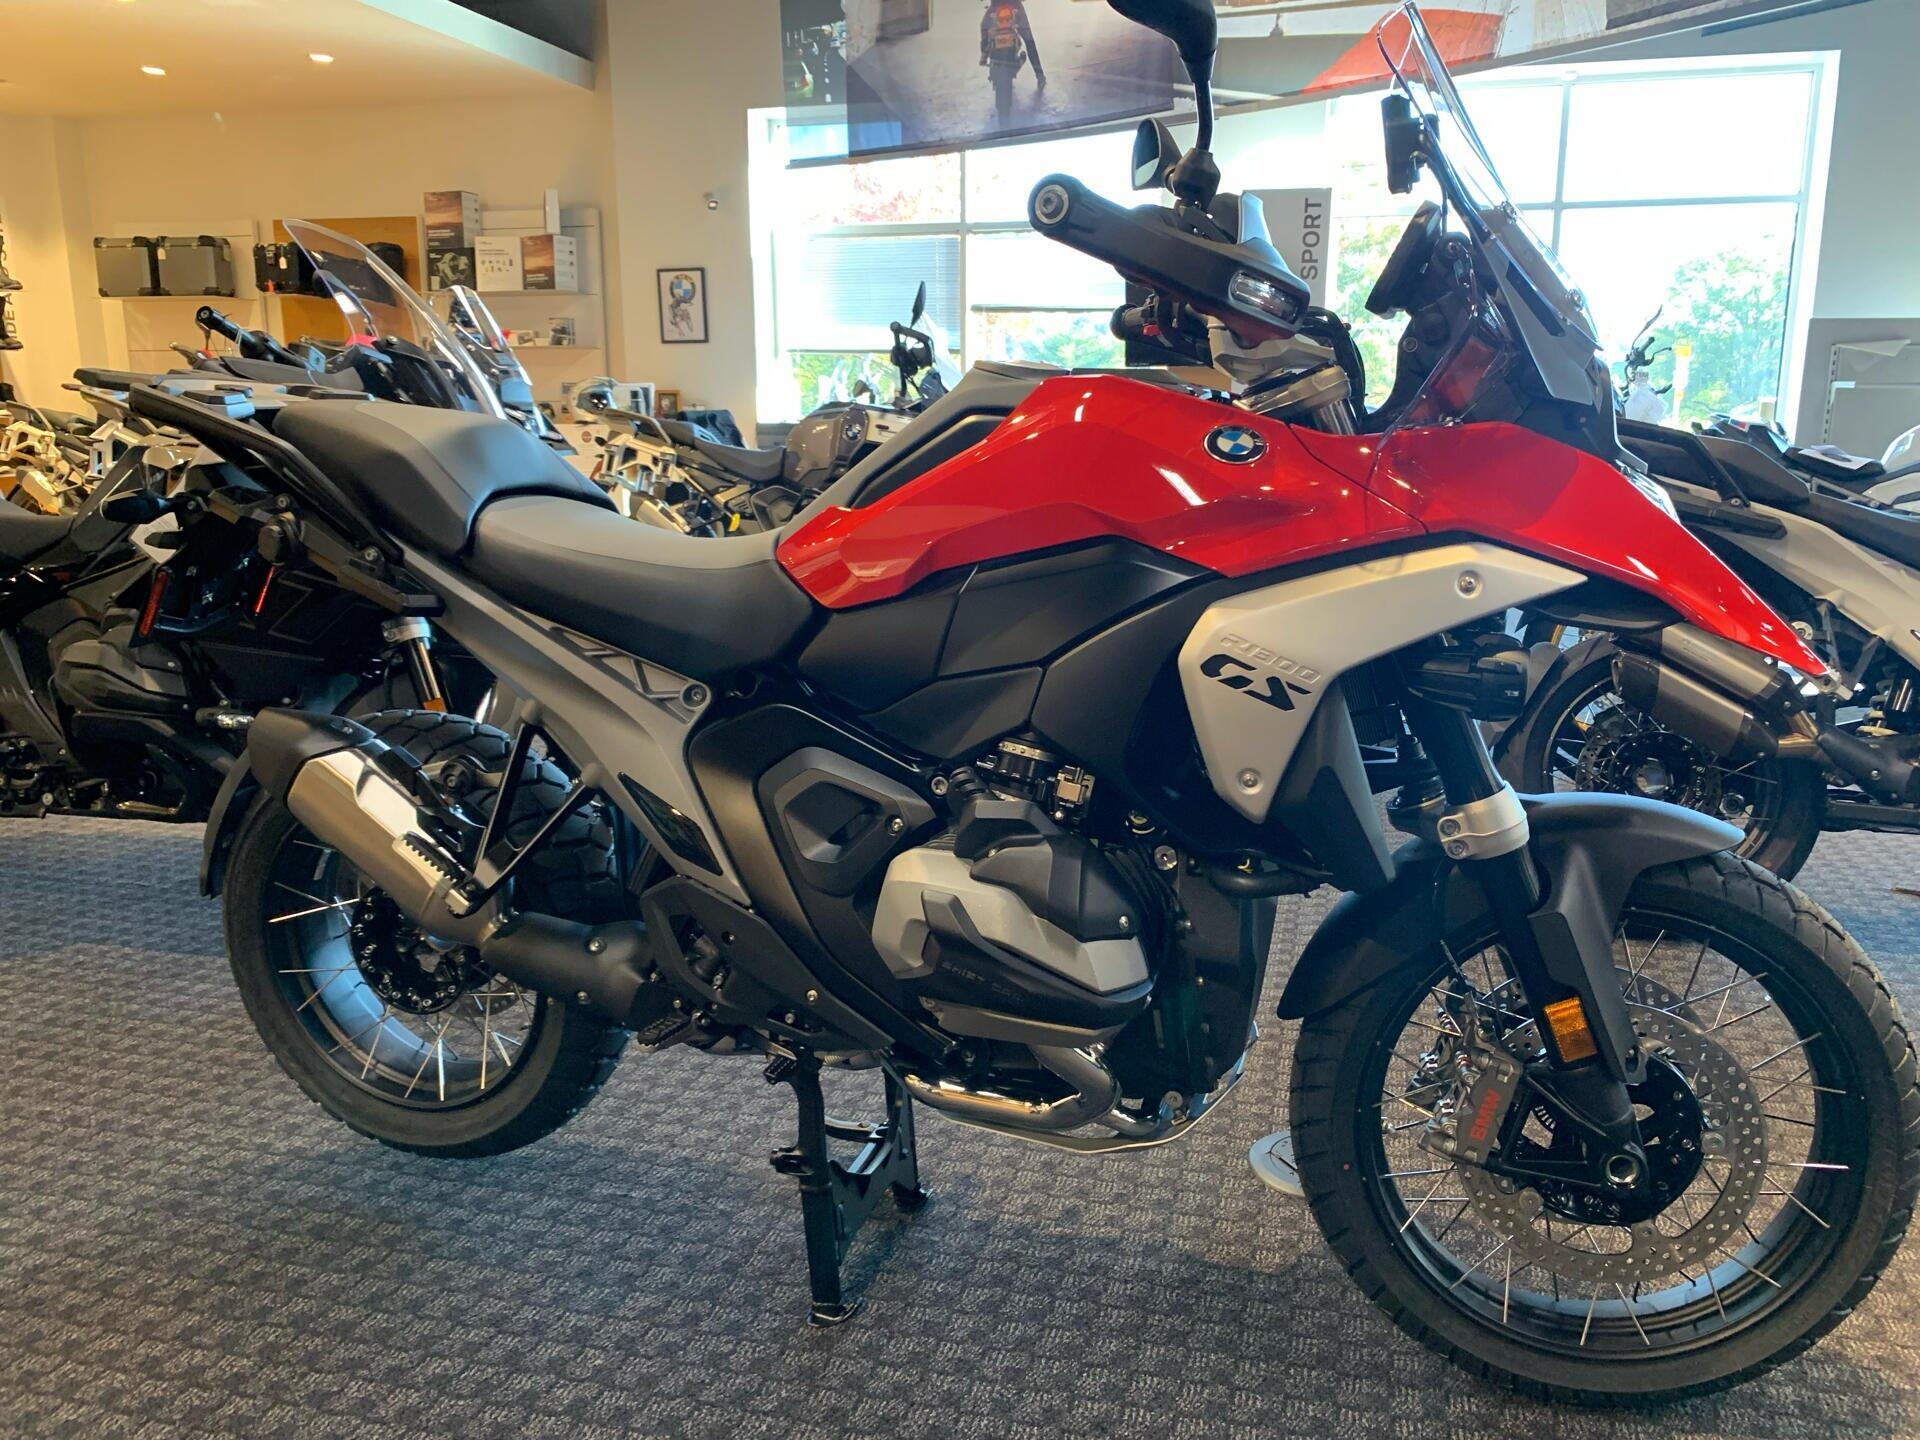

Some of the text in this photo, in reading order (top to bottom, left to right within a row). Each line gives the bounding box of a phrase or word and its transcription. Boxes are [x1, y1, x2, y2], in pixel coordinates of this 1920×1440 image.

[1300, 197, 1322, 280] SPORT
[5, 310, 17, 339] IDE
[1200, 653, 1312, 712] GS
[1220, 633, 1321, 684] R1300
[1470, 1088, 1499, 1141] BMW
